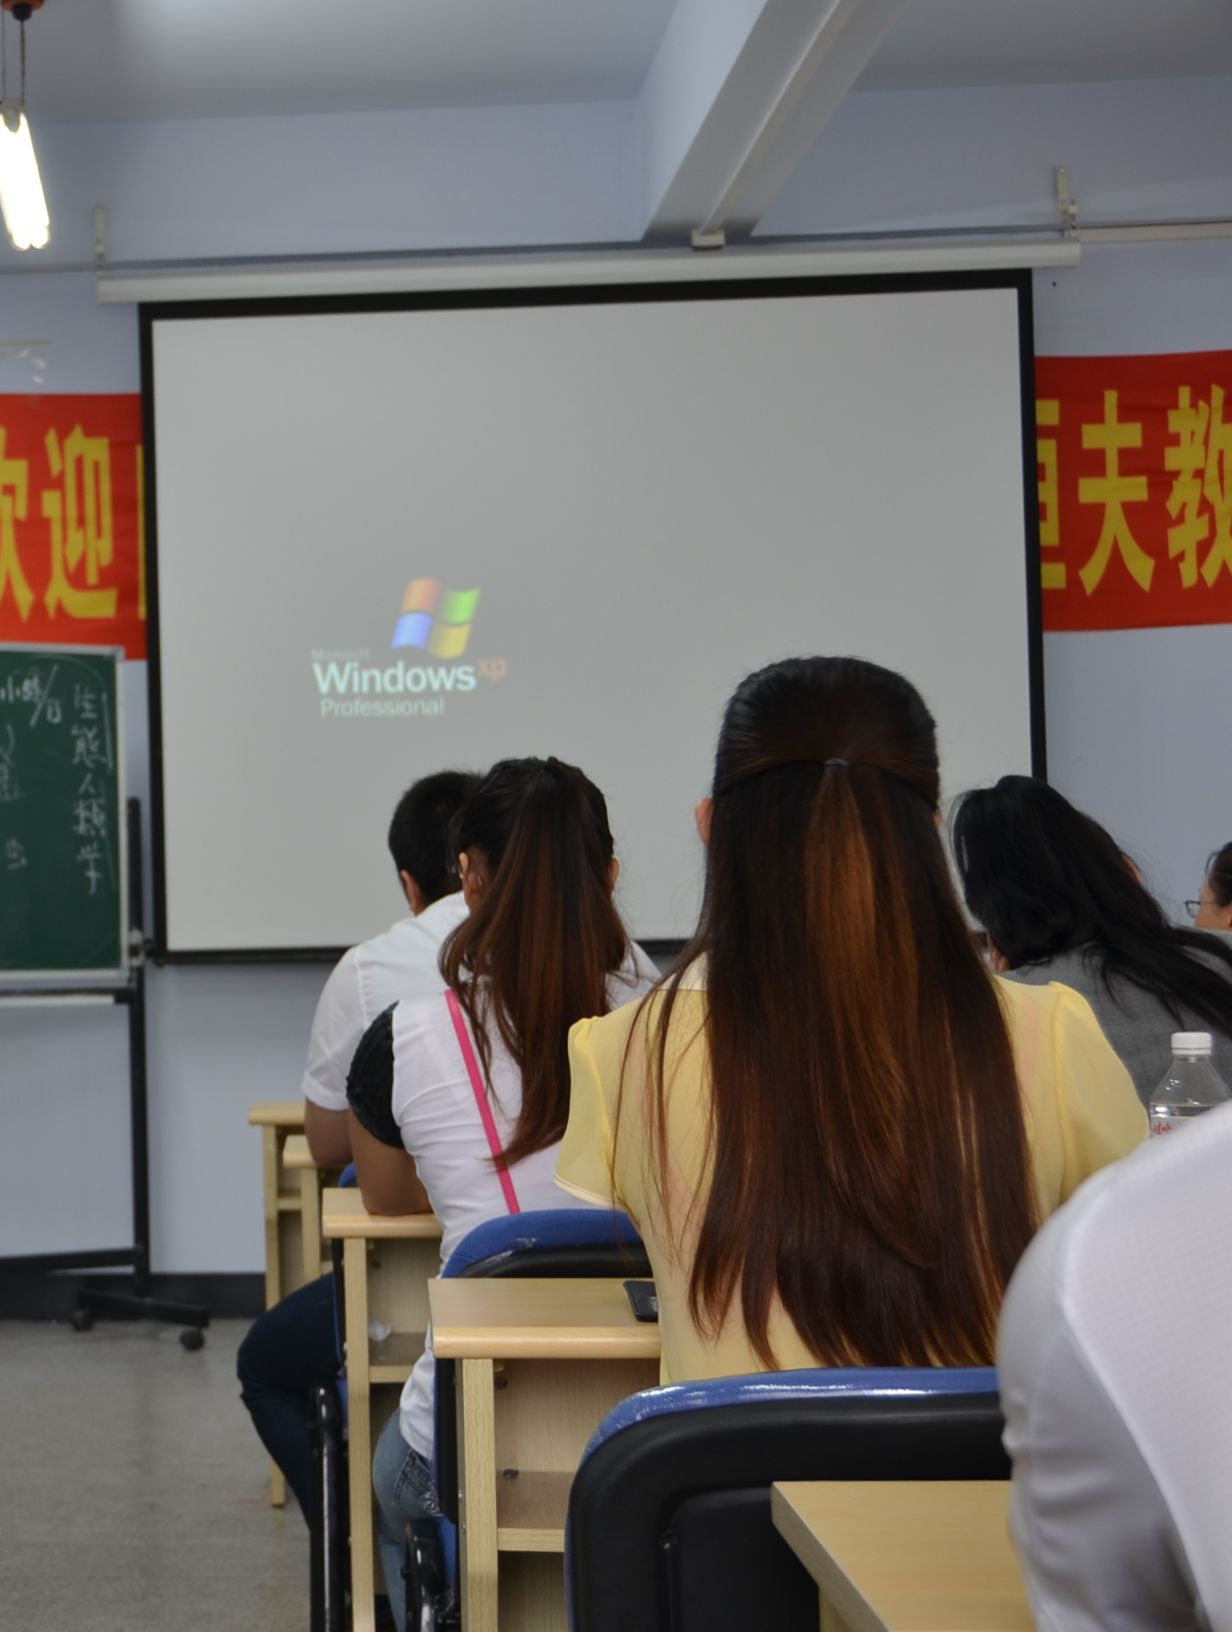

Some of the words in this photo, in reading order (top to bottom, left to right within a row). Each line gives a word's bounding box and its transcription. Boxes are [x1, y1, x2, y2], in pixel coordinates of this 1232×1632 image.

[312, 660, 476, 694] Windows
[478, 657, 508, 679] xp
[321, 696, 444, 718] Professional
